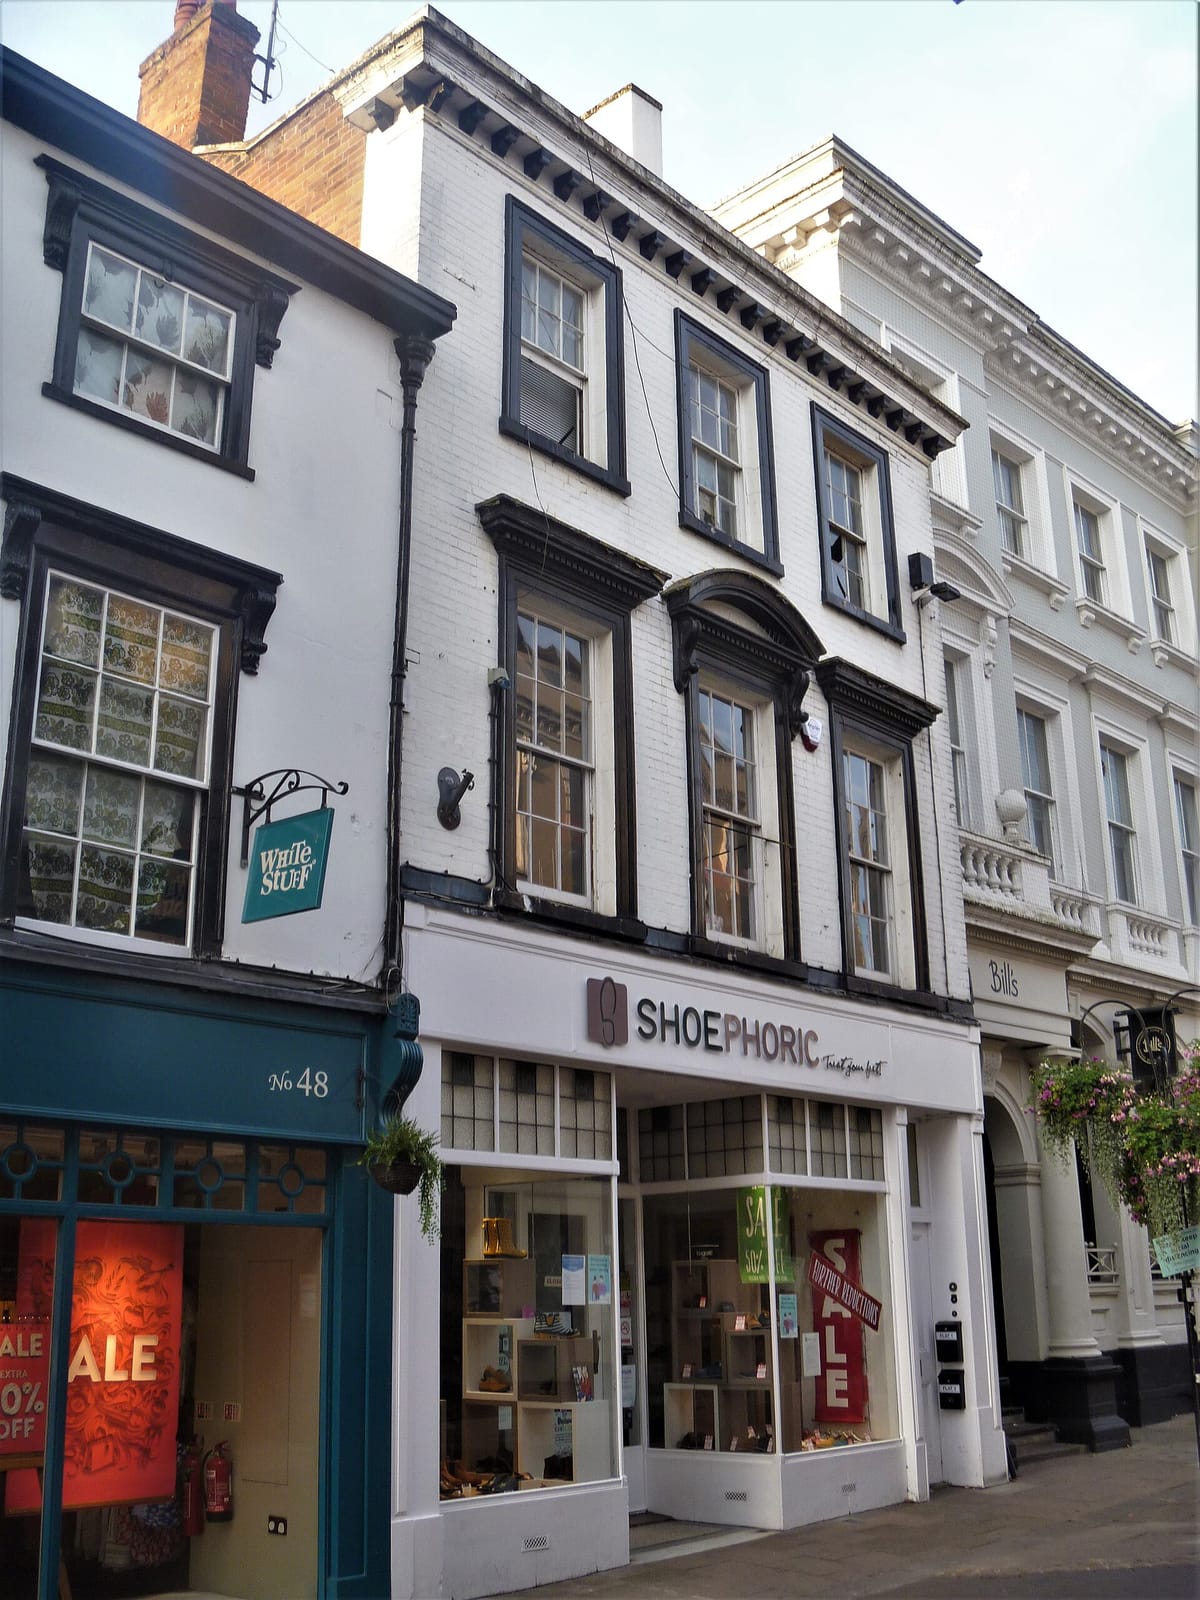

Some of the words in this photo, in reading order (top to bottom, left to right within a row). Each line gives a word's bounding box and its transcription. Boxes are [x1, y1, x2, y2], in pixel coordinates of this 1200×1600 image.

[988, 959, 1019, 997] Bill's
[637, 998, 820, 1068] SHOEPHORIC
[268, 1070, 293, 1091] No
[296, 1066, 329, 1098] 48
[745, 1195, 784, 1238] SAE
[745, 1249, 764, 1275] 50%
[812, 1258, 842, 1297] FURTHER
[841, 1280, 880, 1326] REDUCTIONS
[0, 1333, 43, 1358] ALE
[67, 1334, 159, 1383] ALE
[0, 1369, 28, 1380] EXTRA
[0, 1382, 44, 1416] 0%
